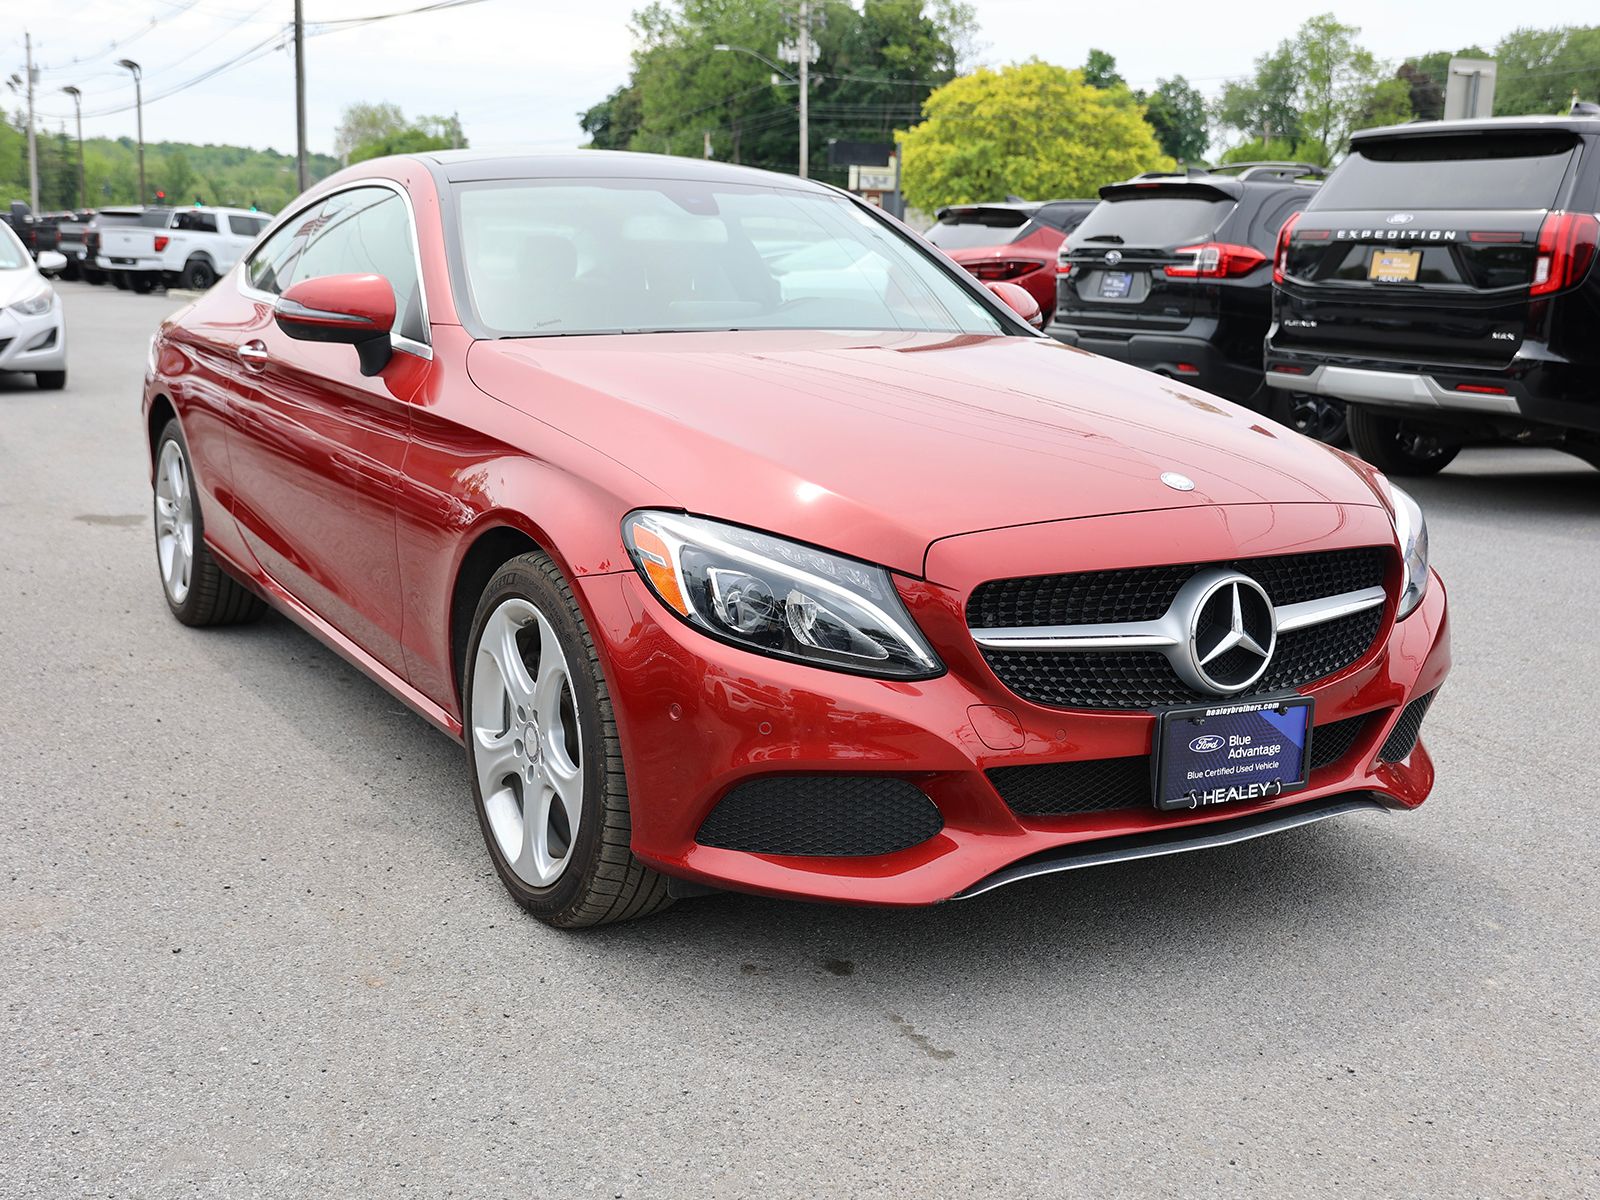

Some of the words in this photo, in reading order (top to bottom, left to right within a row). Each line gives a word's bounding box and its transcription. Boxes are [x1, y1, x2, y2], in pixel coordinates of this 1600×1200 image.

[1337, 230, 1456, 240] EXPEDITION
[1205, 702, 1279, 716] healeybrothers.com
[1195, 737, 1219, 750] Ford
[1229, 734, 1251, 747] Blue
[1228, 744, 1281, 760] Advantage
[1187, 771, 1203, 780] Blue
[1204, 766, 1235, 777] Certified
[1235, 763, 1254, 774] Used
[1255, 760, 1280, 771] Vehicle
[1203, 781, 1271, 806] HEALEY
